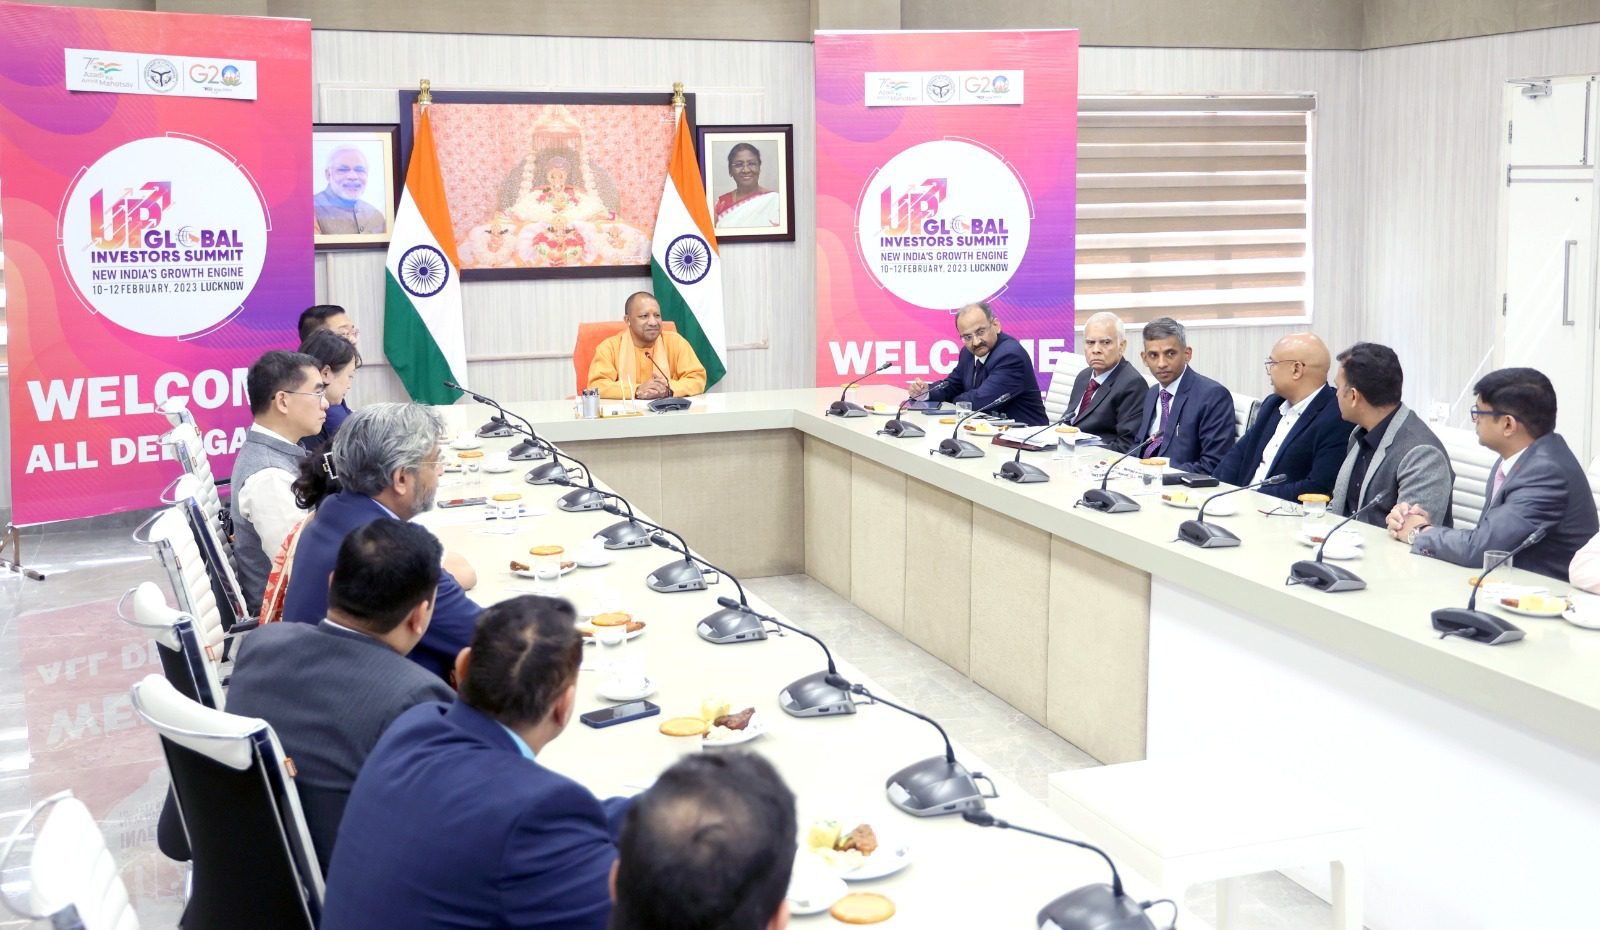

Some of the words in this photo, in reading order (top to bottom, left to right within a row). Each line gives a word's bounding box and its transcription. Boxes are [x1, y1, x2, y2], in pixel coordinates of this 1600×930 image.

[880, 236, 954, 247] INVESTORS
[956, 235, 1009, 246] SUMMIT
[91, 250, 181, 263] INVESTORS
[184, 249, 243, 262] SUMMIT
[880, 252, 900, 261] NEW
[902, 251, 934, 261] INDIA'S
[936, 251, 974, 261] GROWTH
[976, 250, 1009, 260] ENGINE
[92, 269, 117, 281] NEW
[120, 268, 157, 280] INDIA'S
[160, 267, 204, 279] GROWTH
[207, 266, 243, 278] ENGINE
[947, 263, 967, 273] 2023
[970, 263, 1009, 272] LUCKNOW
[174, 282, 197, 293] 2023
[200, 281, 244, 292] LUCKNOW
[25, 440, 99, 475] ALL
